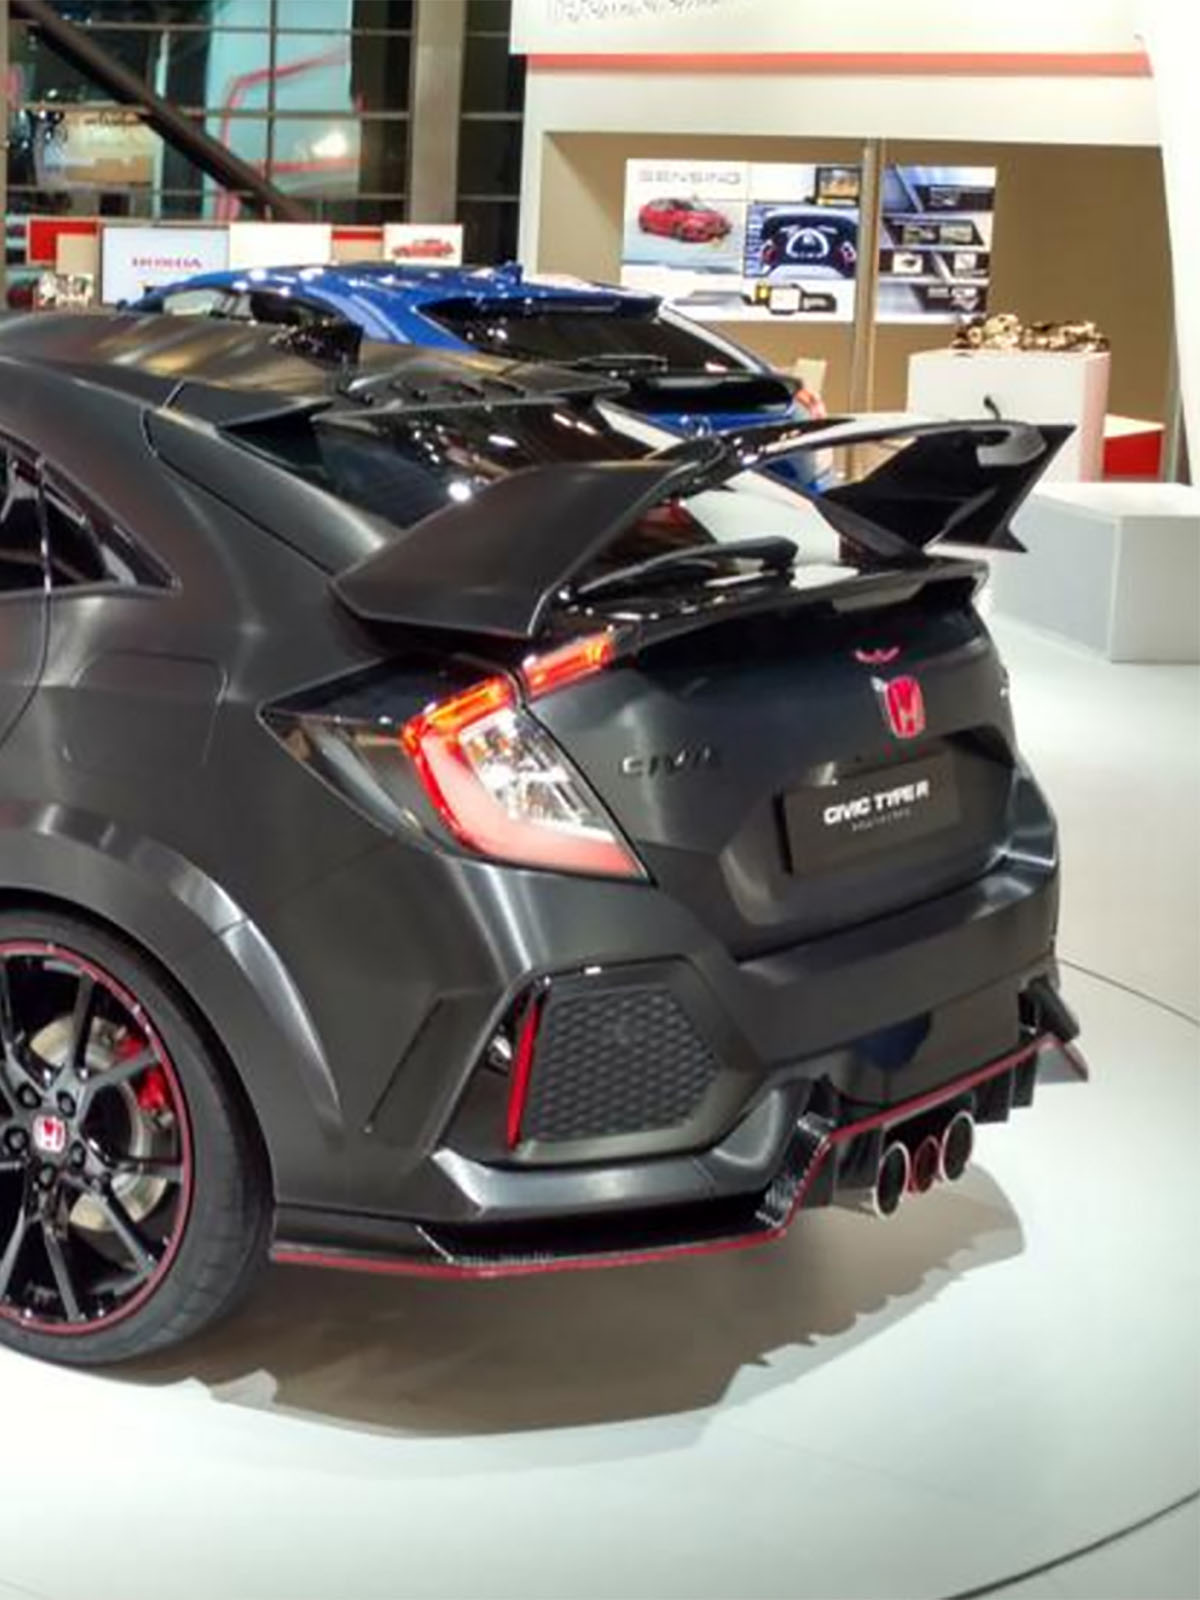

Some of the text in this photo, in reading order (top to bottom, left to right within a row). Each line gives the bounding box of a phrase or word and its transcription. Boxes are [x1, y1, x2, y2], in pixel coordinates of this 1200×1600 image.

[131, 257, 202, 268] HONDA
[823, 797, 871, 825] CIVIC
[874, 784, 915, 811] TYPE
